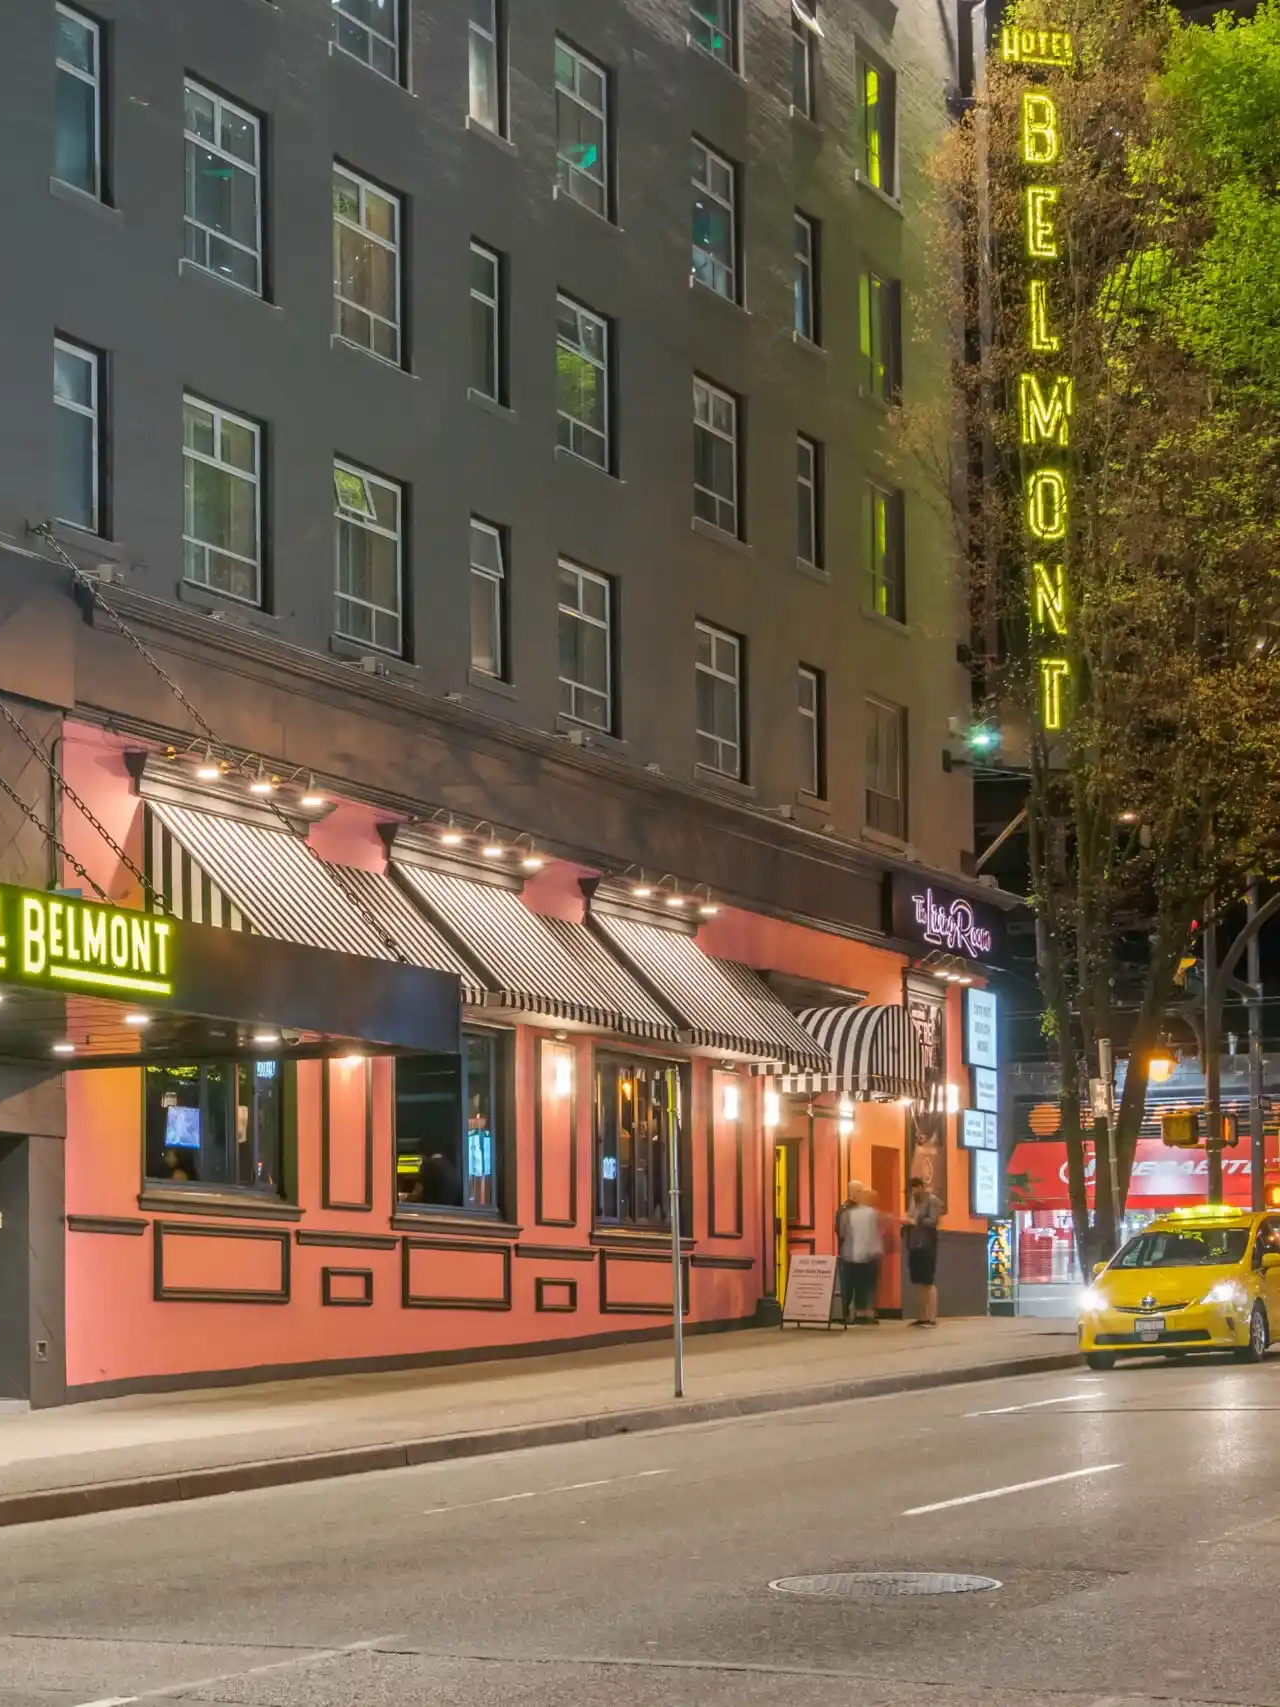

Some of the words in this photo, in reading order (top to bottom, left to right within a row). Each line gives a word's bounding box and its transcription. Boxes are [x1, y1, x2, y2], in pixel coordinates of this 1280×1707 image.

[1003, 26, 1073, 61] HOTEL
[1021, 92, 1072, 729] BELMONT
[23, 897, 171, 974] BELMONT
